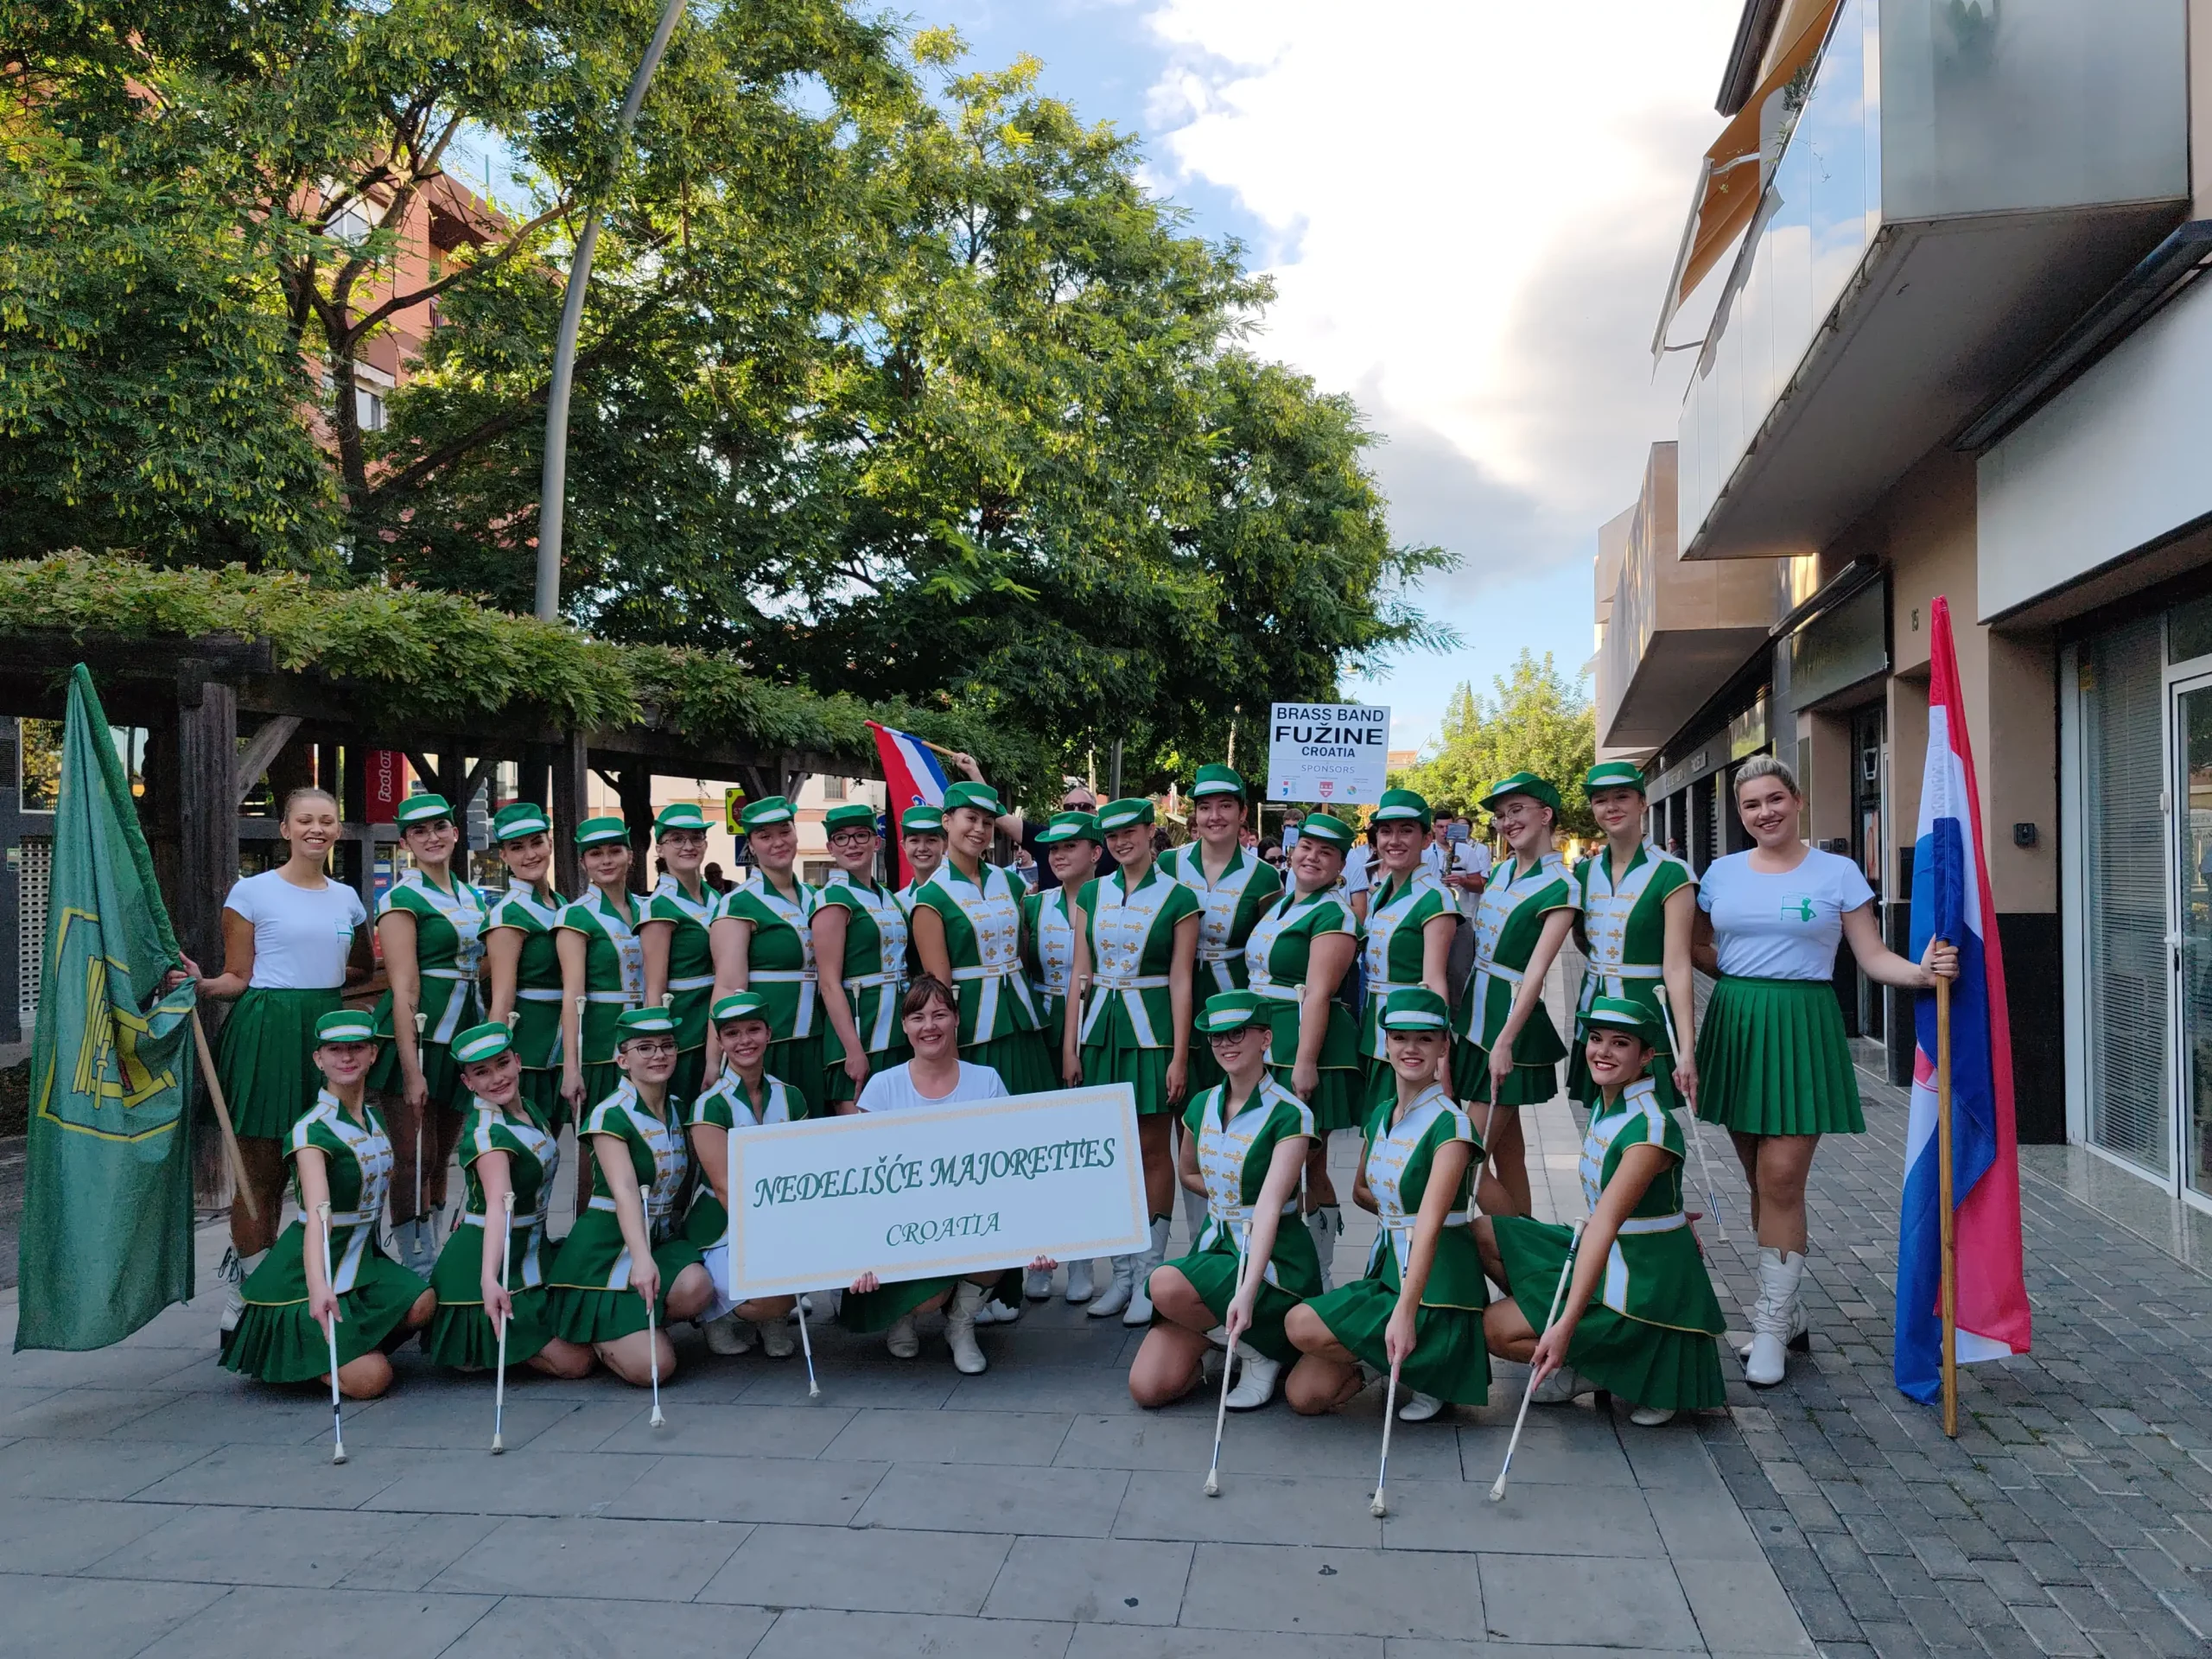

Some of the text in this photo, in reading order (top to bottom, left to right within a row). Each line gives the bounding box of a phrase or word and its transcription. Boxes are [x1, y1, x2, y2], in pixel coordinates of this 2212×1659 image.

[1277, 707, 1384, 721] BRASS BAND
[1275, 722, 1383, 745] FUŽINE
[1301, 746, 1356, 758] CROATIA
[1301, 764, 1356, 773] SPONSORS
[378, 769, 391, 803] Foot
[753, 1137, 1116, 1208] NEDELIŠĆE MAJORETTES
[886, 1211, 1001, 1247] CROATIA
